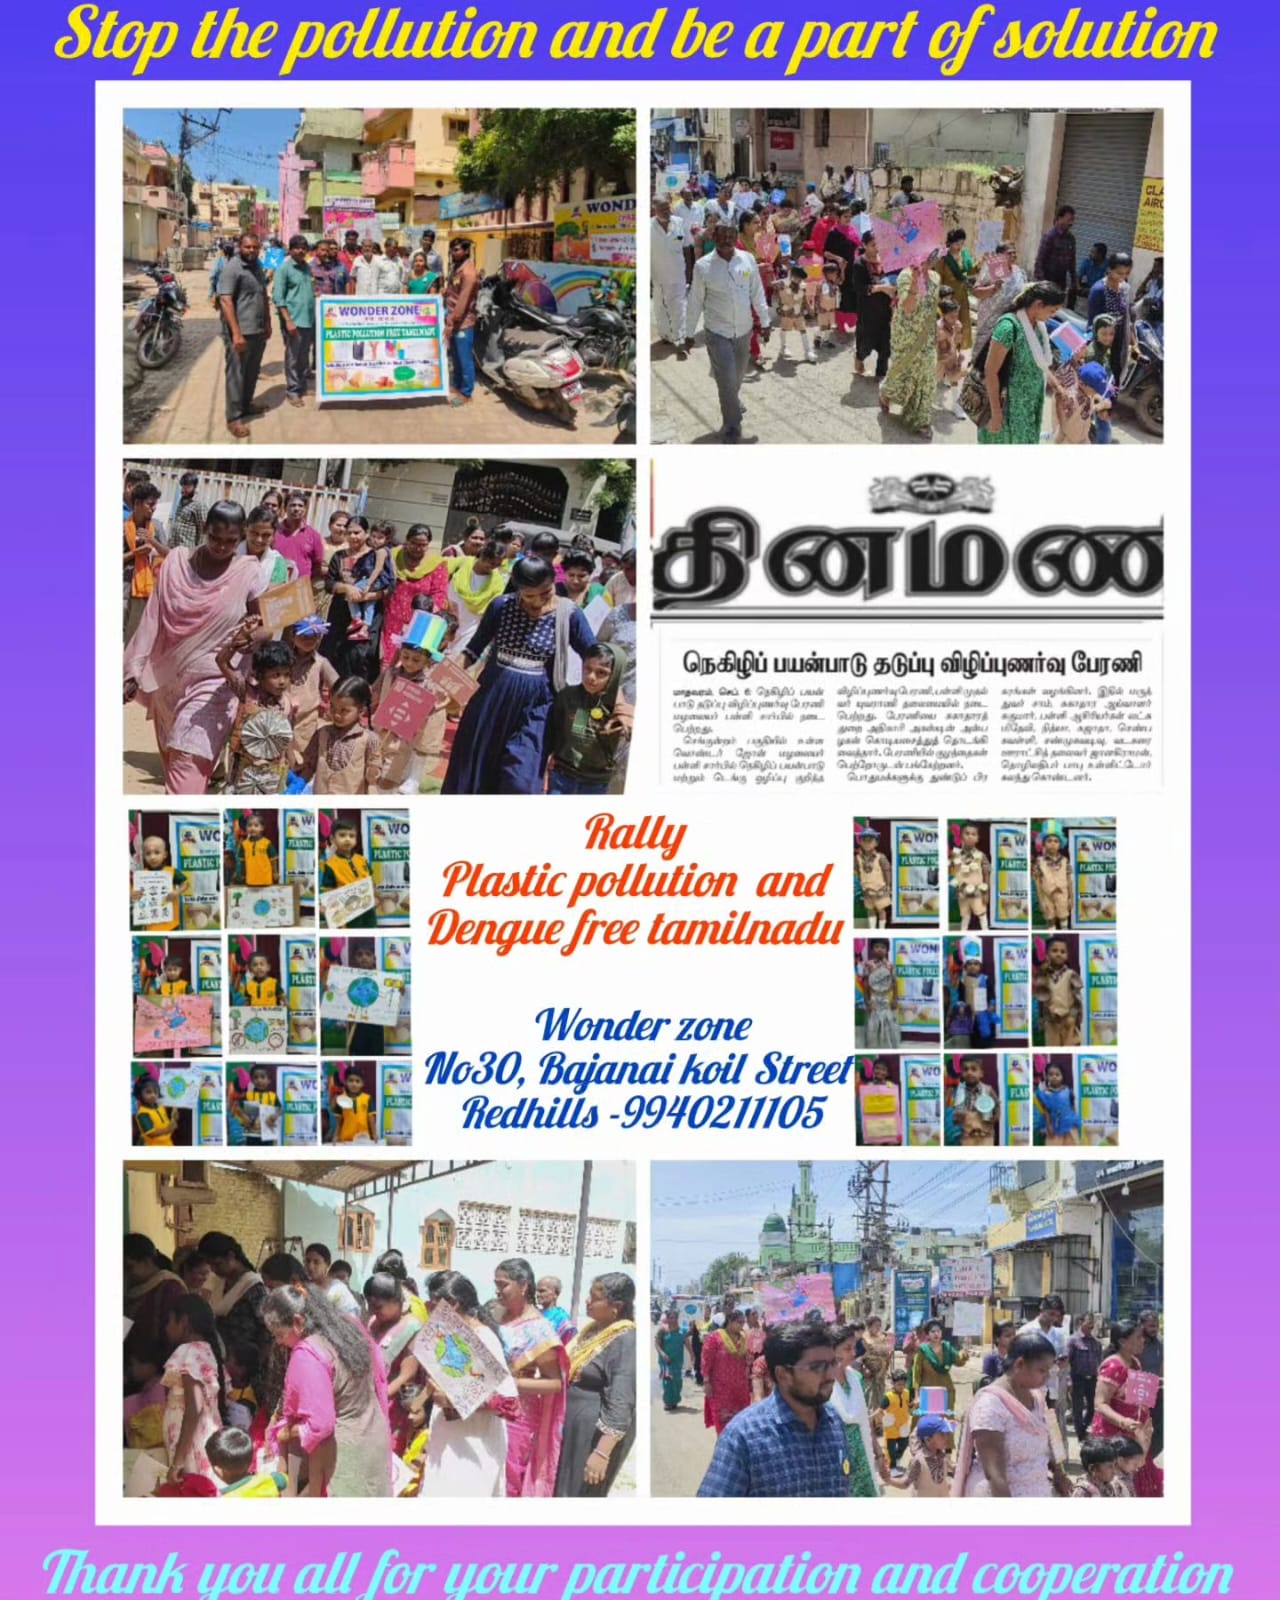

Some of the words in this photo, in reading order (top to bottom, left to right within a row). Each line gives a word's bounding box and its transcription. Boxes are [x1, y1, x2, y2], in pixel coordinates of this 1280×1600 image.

[339, 306, 388, 317] WONDER
[391, 305, 420, 316] ZONE
[683, 650, 768, 679] நெகிழிப்
[773, 651, 867, 677] பயன்பாடு
[873, 651, 934, 677] தடுப்பு
[941, 650, 1066, 679] விழிப்புணர்வு
[1071, 650, 1142, 677] பேரணி
